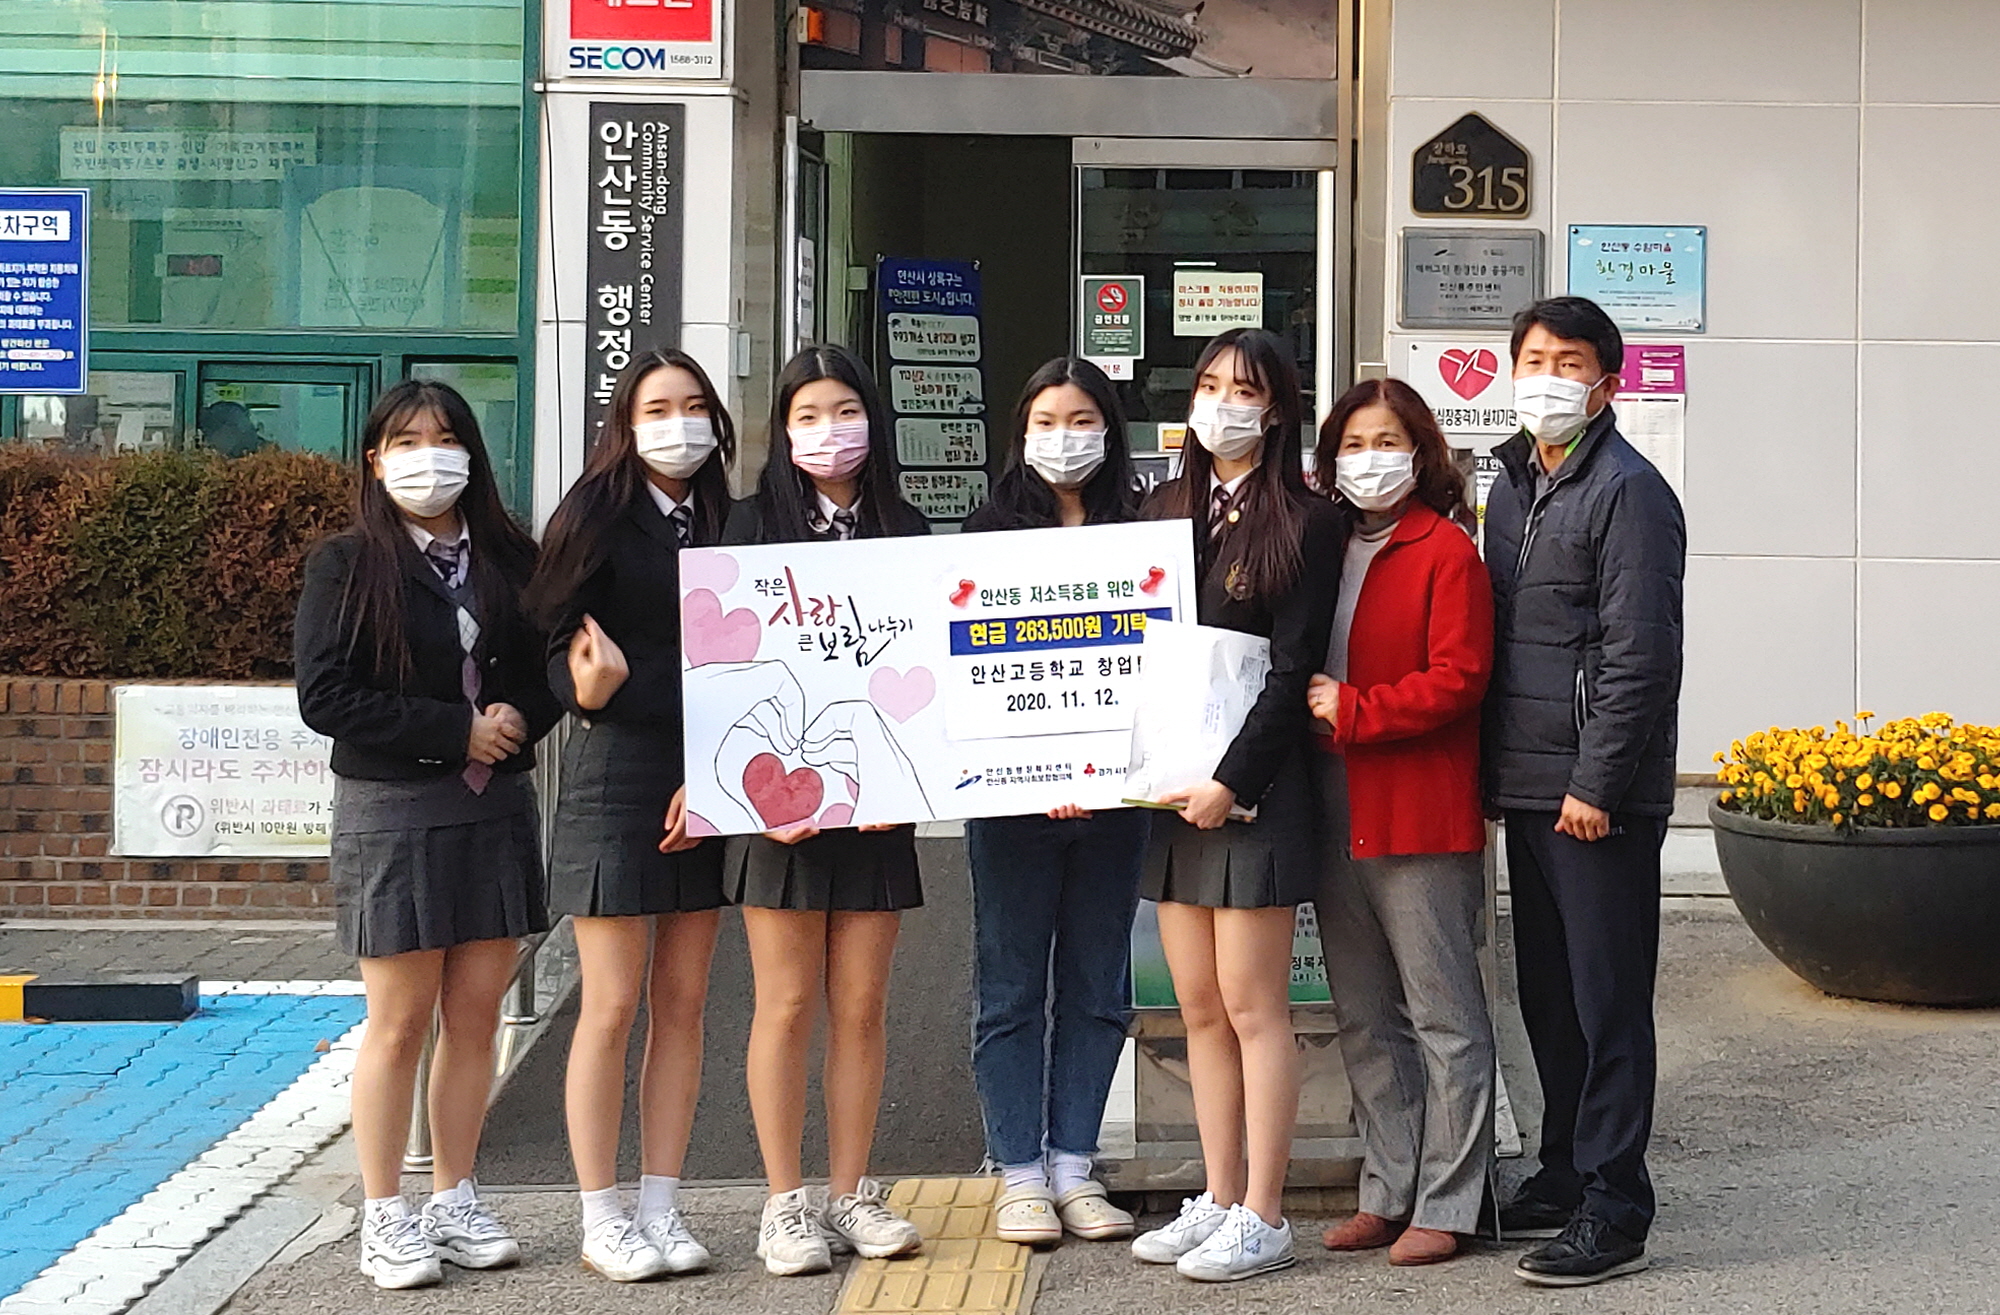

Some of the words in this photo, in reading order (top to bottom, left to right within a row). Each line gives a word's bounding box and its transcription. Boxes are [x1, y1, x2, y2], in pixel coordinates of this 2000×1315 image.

[569, 46, 665, 70] SECOM
[638, 121, 656, 211] Community
[653, 121, 671, 215] Ansan-dong
[596, 120, 639, 251] 안산동
[1444, 165, 1525, 211] 315
[0, 215, 58, 236] 차구역
[640, 215, 656, 269] Service
[639, 274, 655, 325] Center
[1433, 408, 1480, 427] 심장충격기
[754, 577, 786, 597] 작은
[768, 565, 843, 627] 사랑
[980, 587, 1022, 607] 안산동
[1107, 579, 1135, 599] 위한
[797, 634, 814, 651] 큰
[868, 616, 913, 640] 나누기
[969, 620, 1007, 646] 현금
[1015, 614, 1103, 643] 263,500원
[970, 659, 1085, 685] 안산고등학교
[1097, 655, 1142, 677] 창업
[1006, 692, 1052, 712] 2020.
[1061, 690, 1085, 708] 11.
[1094, 688, 1119, 705] 12.
[177, 727, 282, 752] 장애인전용
[138, 758, 242, 784] 잠시라도
[250, 759, 331, 784] 주차하
[210, 798, 255, 816] 위반시
[214, 822, 255, 835] (위반시
[260, 822, 297, 835] 10만원
